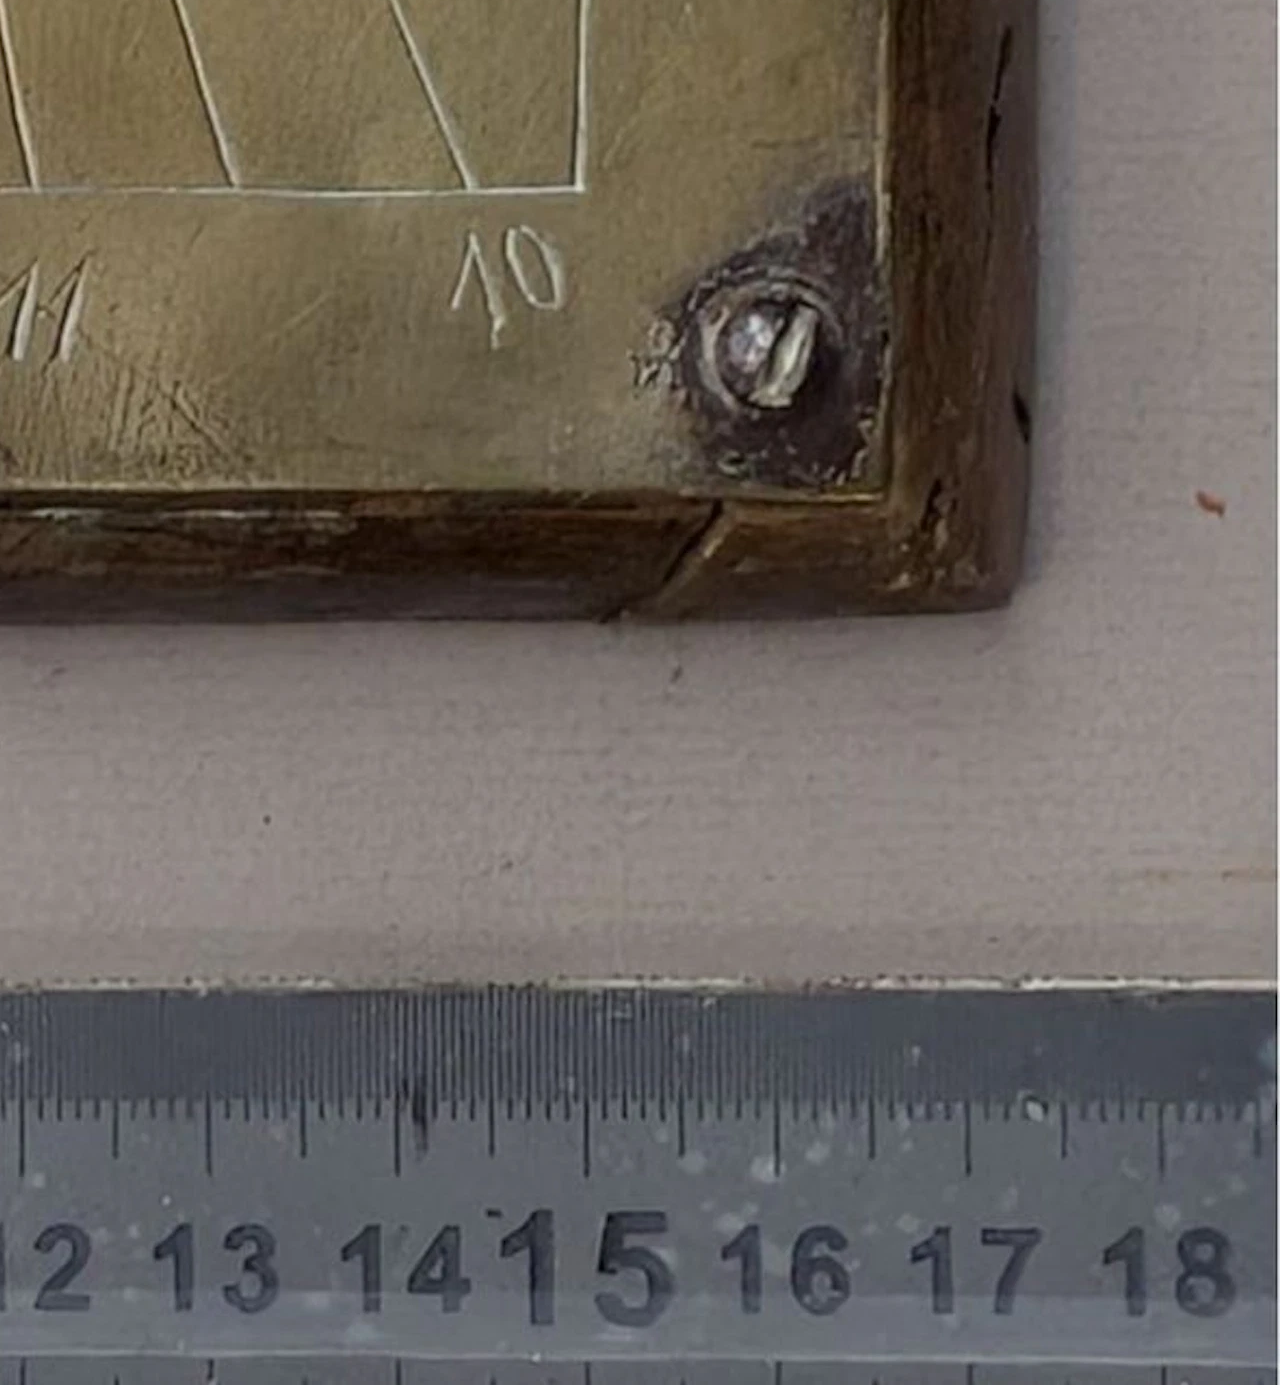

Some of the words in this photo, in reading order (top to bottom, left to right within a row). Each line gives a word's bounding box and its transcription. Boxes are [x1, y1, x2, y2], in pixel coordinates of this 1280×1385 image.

[450, 225, 565, 350] 10
[152, 1223, 280, 1314] 13
[339, 1224, 471, 1313] 14
[499, 1208, 674, 1327] 15
[720, 1224, 851, 1316] 16
[909, 1226, 1042, 1315] 17
[1101, 1226, 1237, 1318] 18
